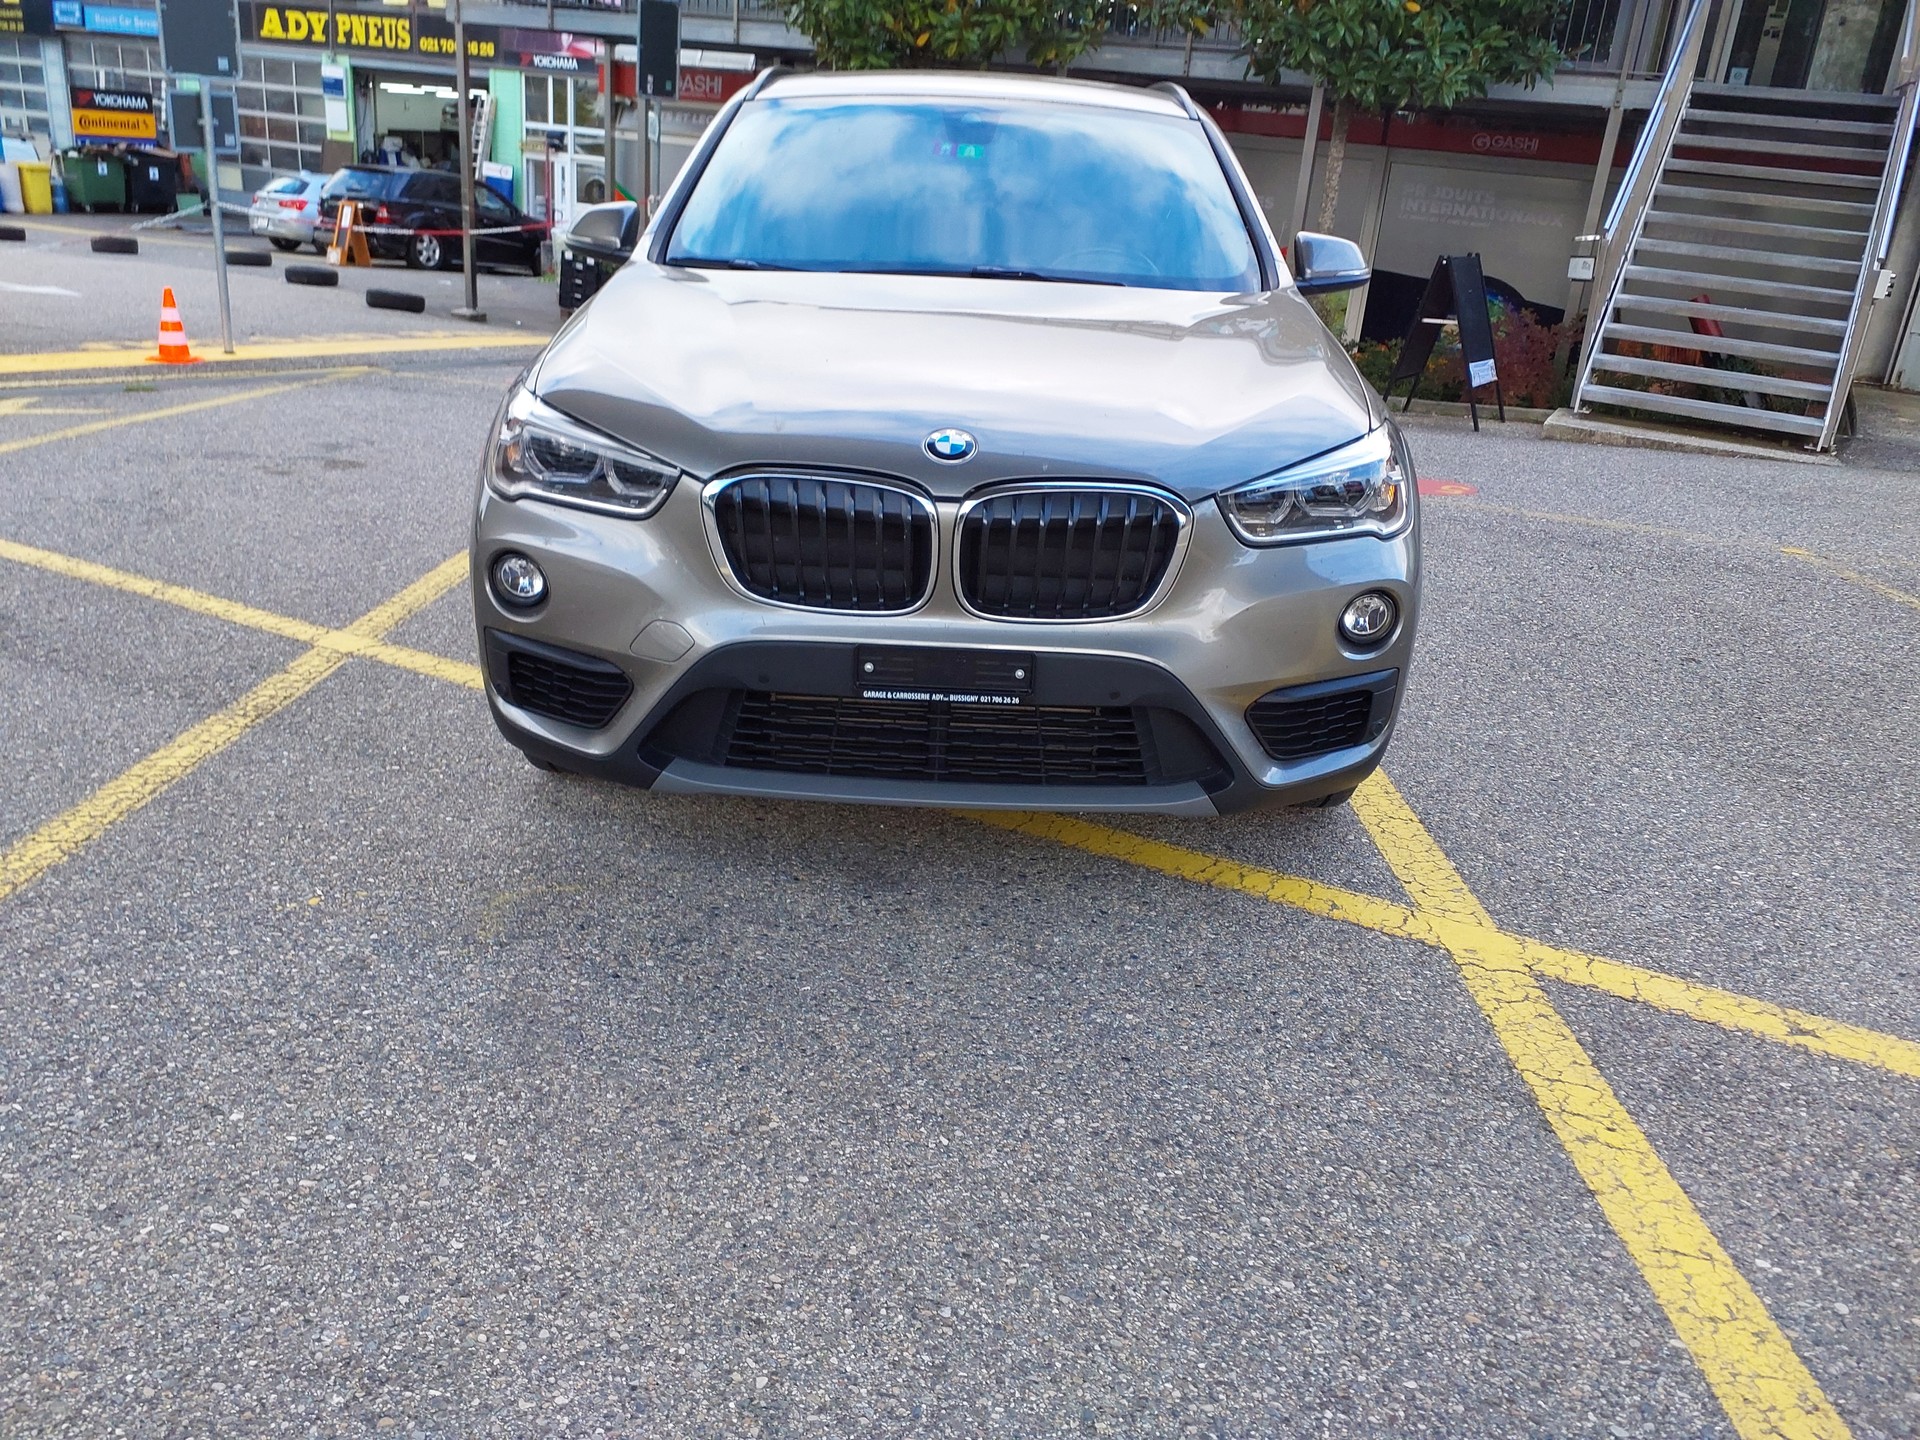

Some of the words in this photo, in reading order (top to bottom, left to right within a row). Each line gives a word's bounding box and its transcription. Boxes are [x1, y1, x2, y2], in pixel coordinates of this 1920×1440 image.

[260, 7, 329, 43] ADY
[335, 12, 411, 50] PNEUS
[420, 36, 439, 53] 021
[533, 54, 579, 70] YOKOHAMA
[679, 73, 723, 97] ASHI
[93, 92, 148, 110] YOKOHAMA
[79, 114, 140, 130] Continental
[1491, 135, 1539, 152] GASHI
[863, 690, 886, 699] GARAGE
[892, 691, 930, 701] CARROSSERIE
[949, 694, 979, 703] BUSSIGNY
[980, 695, 991, 703] 021
[1011, 696, 1020, 704] 26
